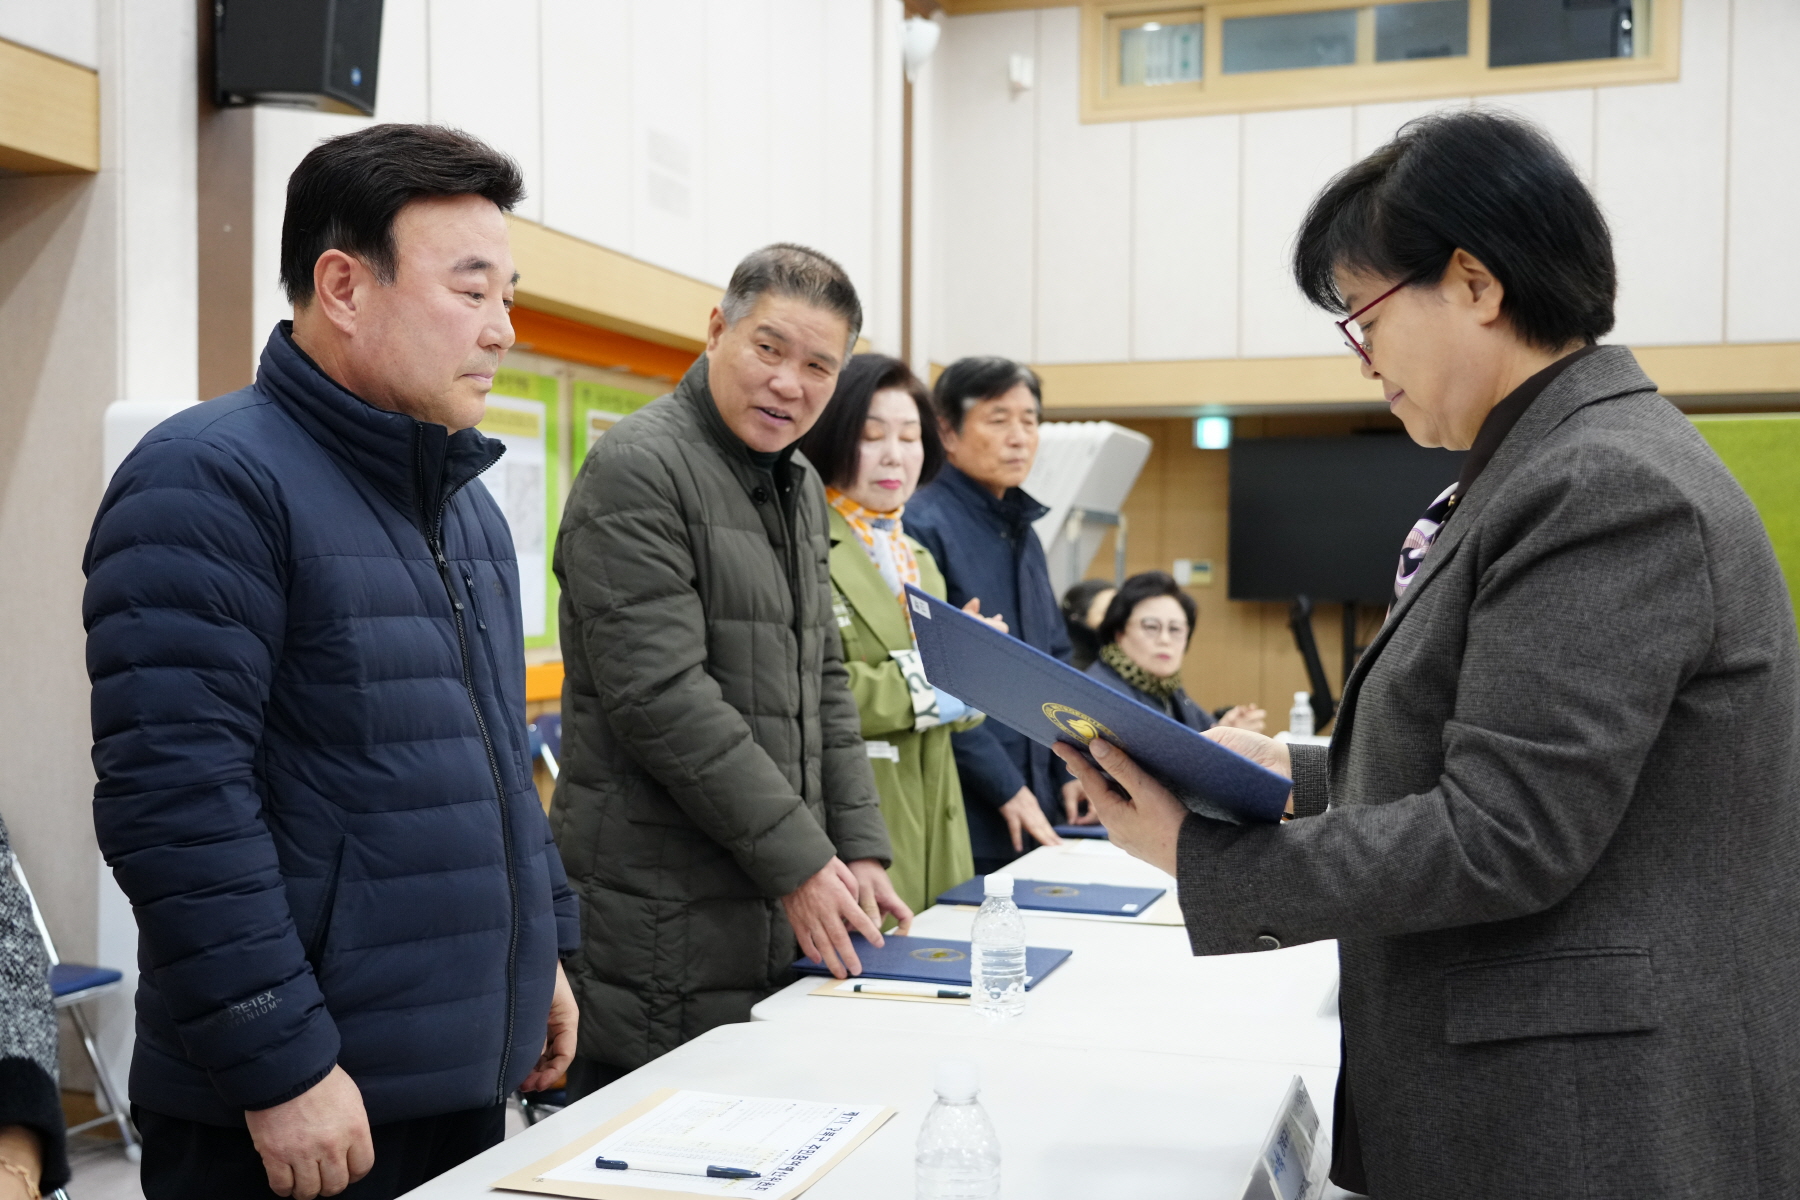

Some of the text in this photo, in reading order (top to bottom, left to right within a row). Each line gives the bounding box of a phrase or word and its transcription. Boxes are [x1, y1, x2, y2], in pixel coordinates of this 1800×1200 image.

[833, 1111, 861, 1124] 제7기
[814, 1127, 843, 1142] 강북구
[751, 1144, 822, 1191] 주민참여예산위원회
